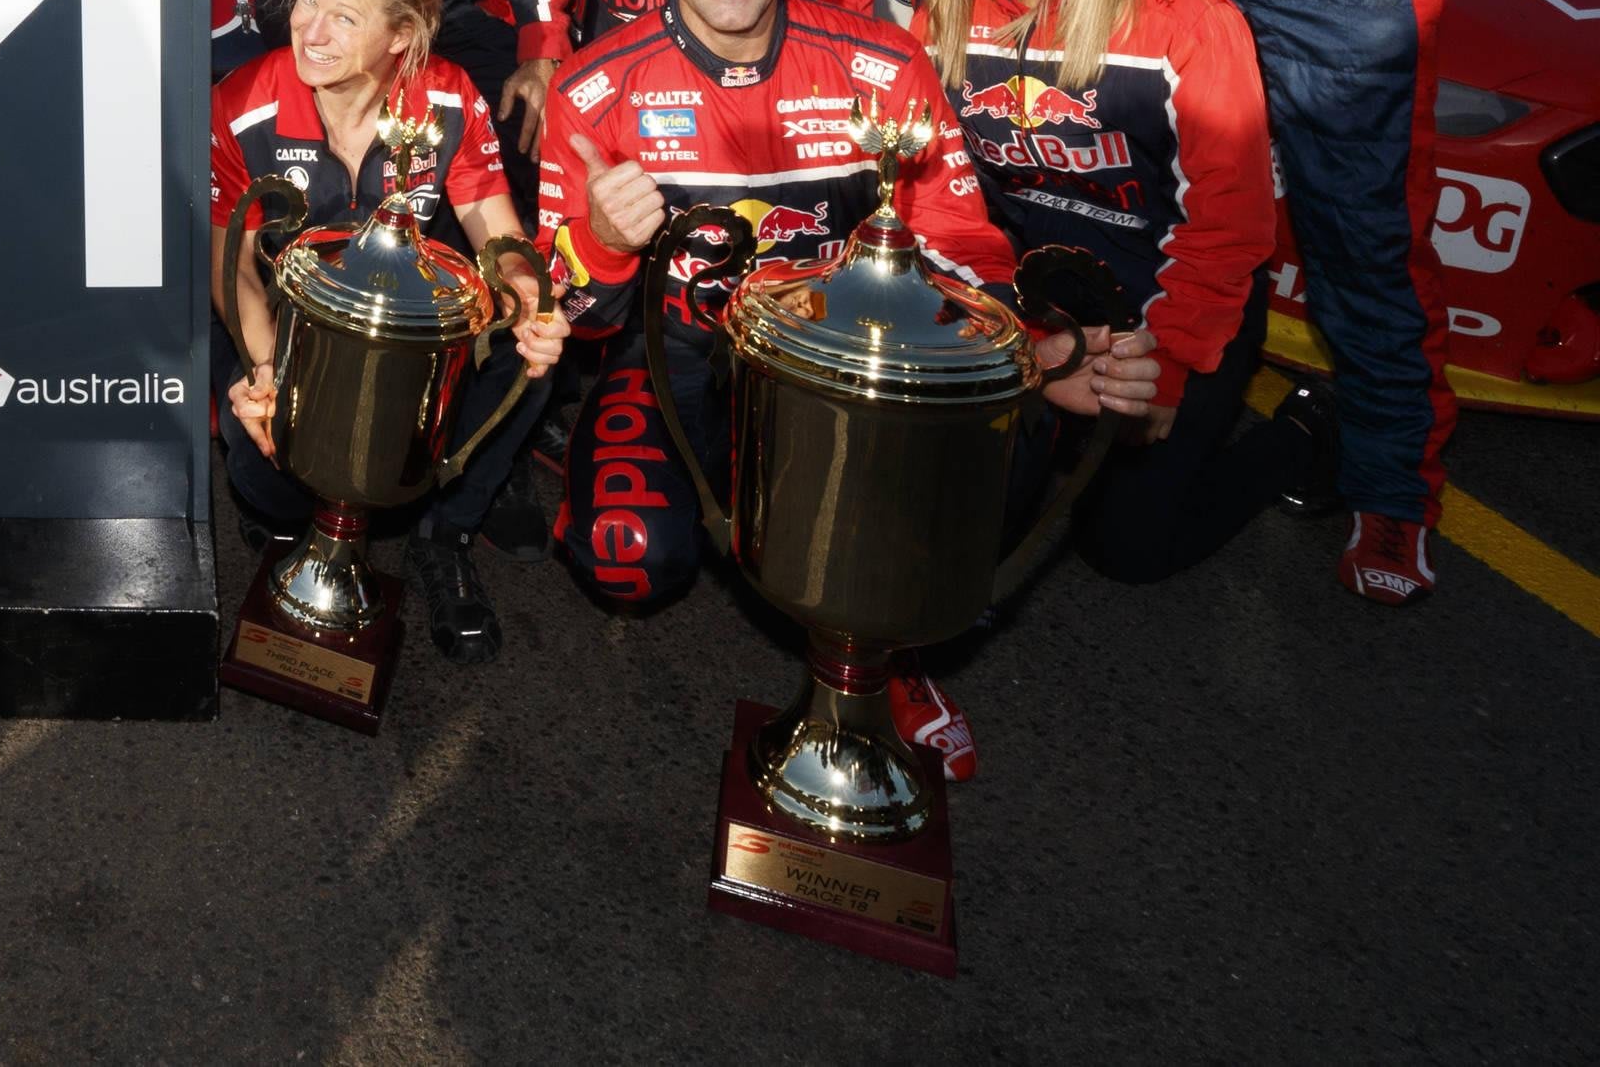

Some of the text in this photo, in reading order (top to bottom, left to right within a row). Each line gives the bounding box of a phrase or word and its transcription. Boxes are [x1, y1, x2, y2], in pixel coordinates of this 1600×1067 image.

[851, 57, 897, 84] OMP
[572, 75, 610, 108] OMP
[645, 91, 703, 105] CALTEX
[276, 149, 318, 162] CALTEX
[640, 151, 698, 161] TW STEEL
[1031, 132, 1132, 173] Bull
[1086, 204, 1136, 227] TEAM
[16, 372, 184, 405] australia
[592, 368, 671, 600] Holden
[266, 649, 336, 679] THIRD PLACE
[279, 663, 307, 678] RACE
[786, 865, 881, 903] WINNER
[795, 883, 869, 913] RACE 18
